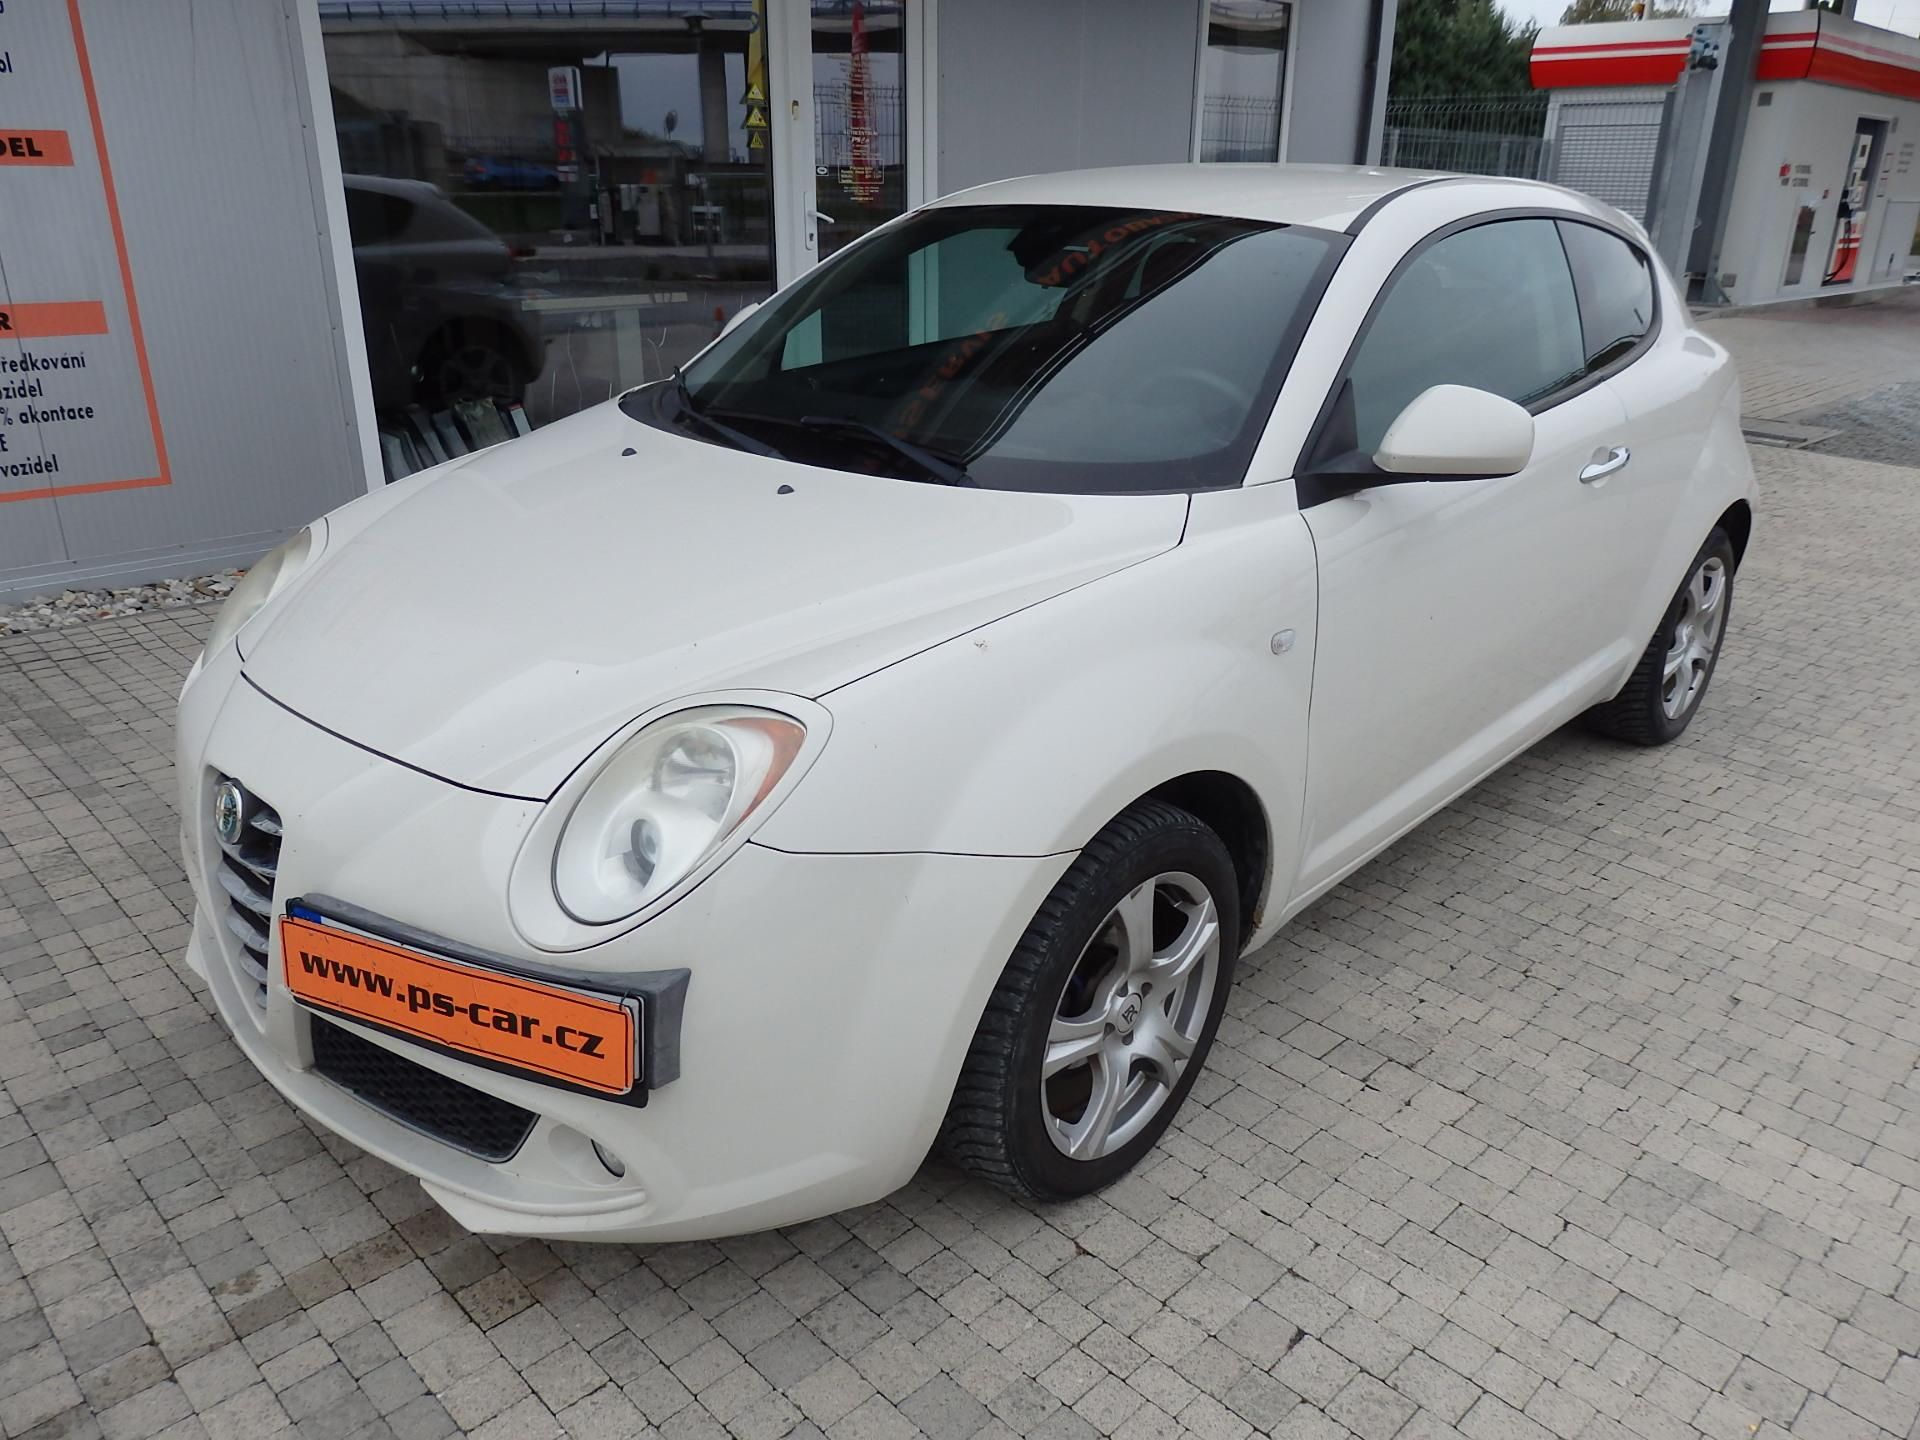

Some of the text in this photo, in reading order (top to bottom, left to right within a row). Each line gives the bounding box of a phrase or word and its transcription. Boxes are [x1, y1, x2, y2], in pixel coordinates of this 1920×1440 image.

[19, 404, 94, 425] akontace
[0, 453, 59, 478] vozidel
[299, 951, 605, 1060] www.ps-car.cz
